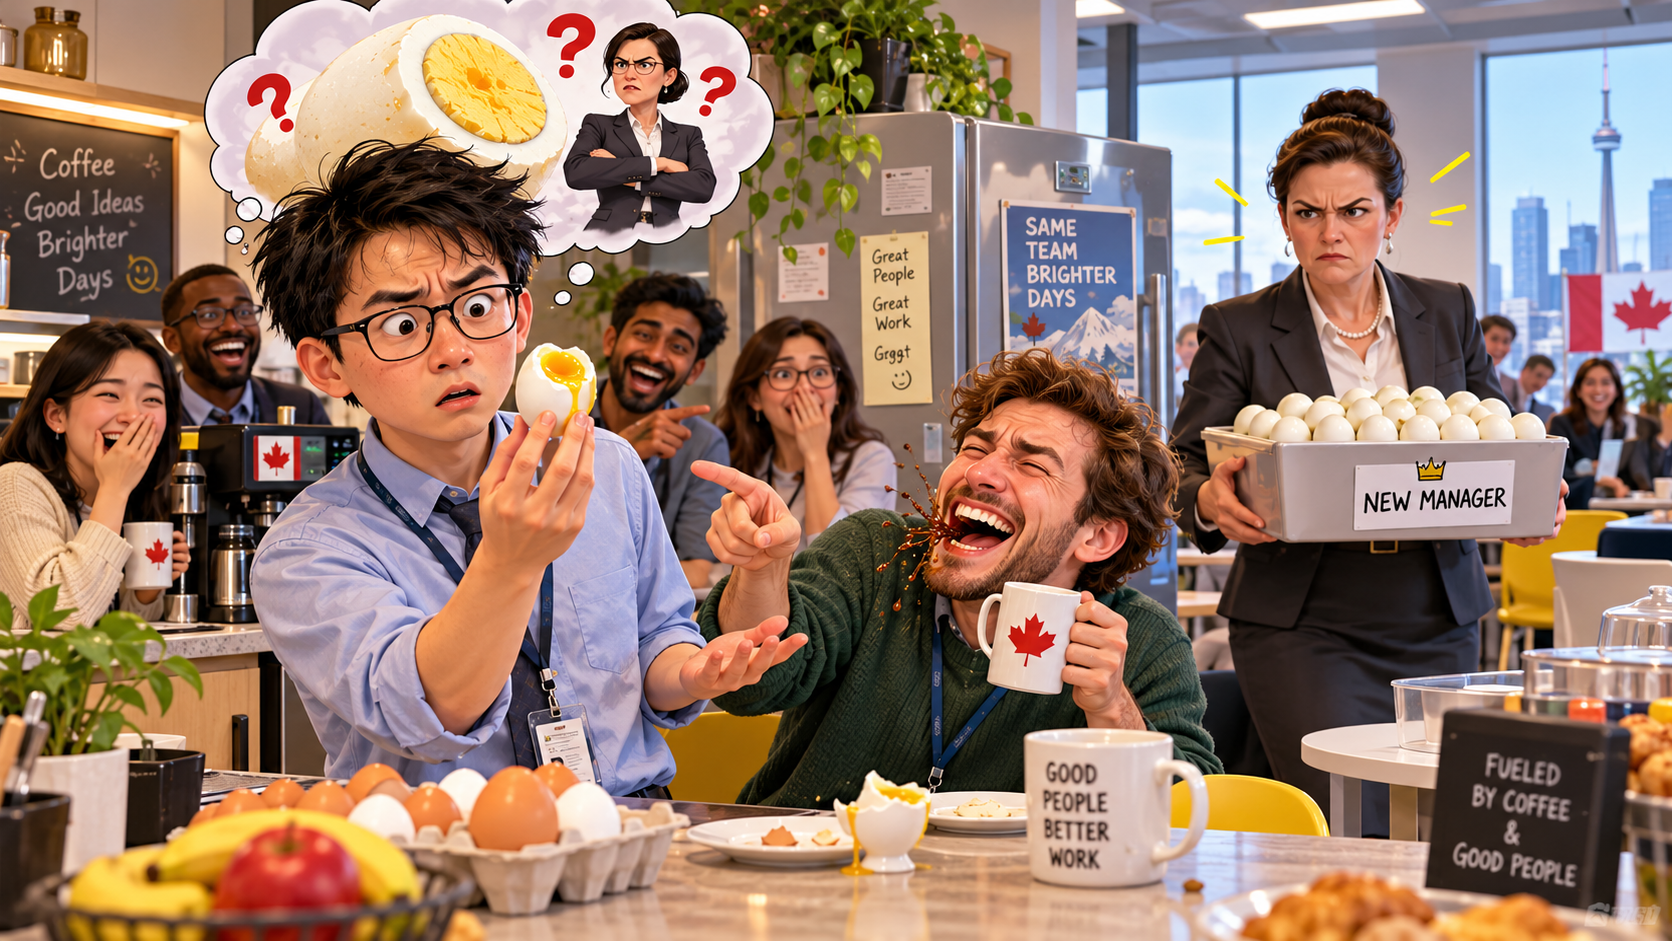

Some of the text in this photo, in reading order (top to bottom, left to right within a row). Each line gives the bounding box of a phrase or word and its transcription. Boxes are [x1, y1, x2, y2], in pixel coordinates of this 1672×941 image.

[39, 148, 116, 180] Coffee
[24, 189, 144, 223] Good Ideas
[1025, 216, 1077, 237] SAME
[37, 225, 129, 263] Brighter
[1026, 240, 1078, 261] TEAM
[872, 247, 909, 265] Great
[57, 266, 114, 301] Days
[873, 265, 915, 286] People
[1027, 265, 1117, 285] BRIGHTER
[873, 295, 909, 312] Great
[1027, 288, 1076, 309] DAYS
[875, 313, 912, 331] Work
[1363, 487, 1506, 514] NEW MANAGER
[1046, 761, 1097, 785] GOOD
[1485, 752, 1562, 787] FUELED
[1043, 790, 1108, 813] PEOPLE
[1472, 784, 1572, 822] BY COFFEE
[1044, 819, 1110, 842] BETTER
[1503, 820, 1521, 846] &
[1049, 847, 1100, 870] WORK
[1452, 842, 1577, 887] GOOD PEOPLE
